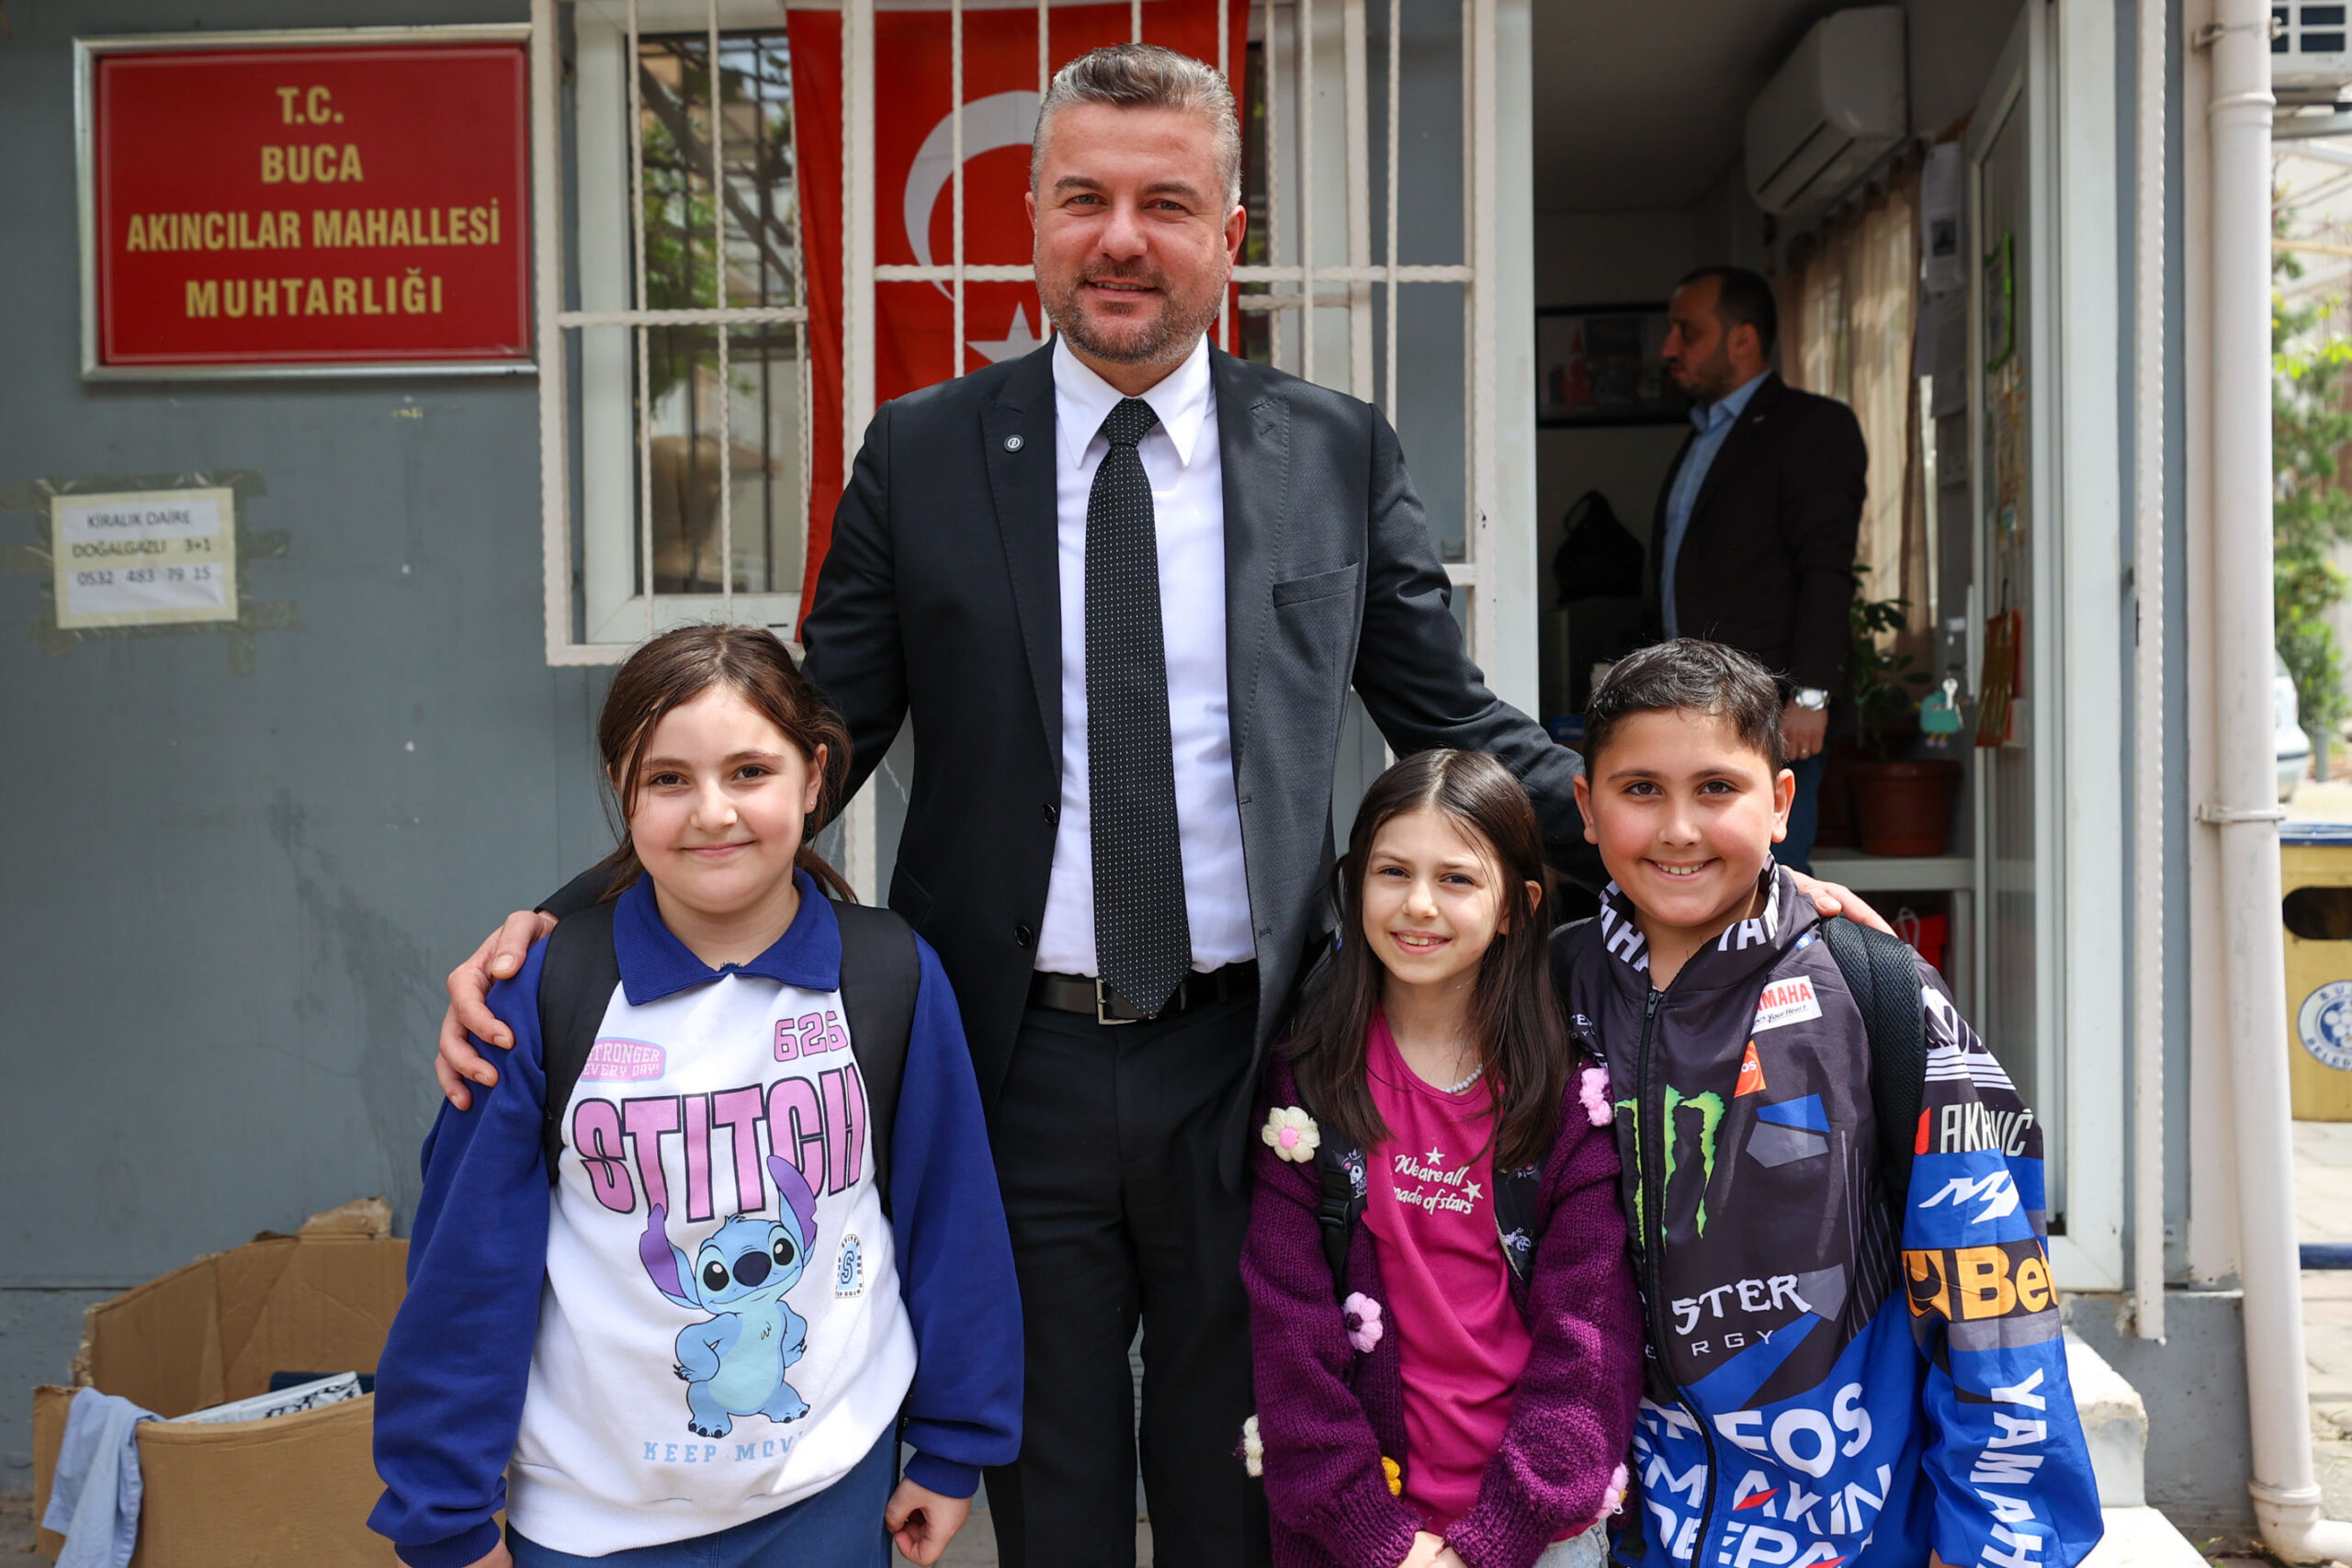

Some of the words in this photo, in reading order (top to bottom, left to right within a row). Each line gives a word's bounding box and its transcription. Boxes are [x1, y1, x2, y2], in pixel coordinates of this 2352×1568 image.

[277, 85, 344, 124] T.C.
[261, 143, 364, 184] BUCA
[126, 209, 301, 252] AKINCILAR
[312, 197, 500, 248] MAHALLESİ
[185, 266, 443, 318] MUHTARLIĞI
[193, 566, 212, 581] 15
[775, 1010, 848, 1062] 626
[572, 1063, 866, 1224] STITCH
[1395, 1155, 1419, 1177] We
[1418, 1166, 1443, 1183] are
[1442, 1166, 1470, 1187] all
[1422, 1189, 1446, 1215] of
[1437, 1193, 1475, 1214] stars
[643, 1441, 717, 1463] KEEP
